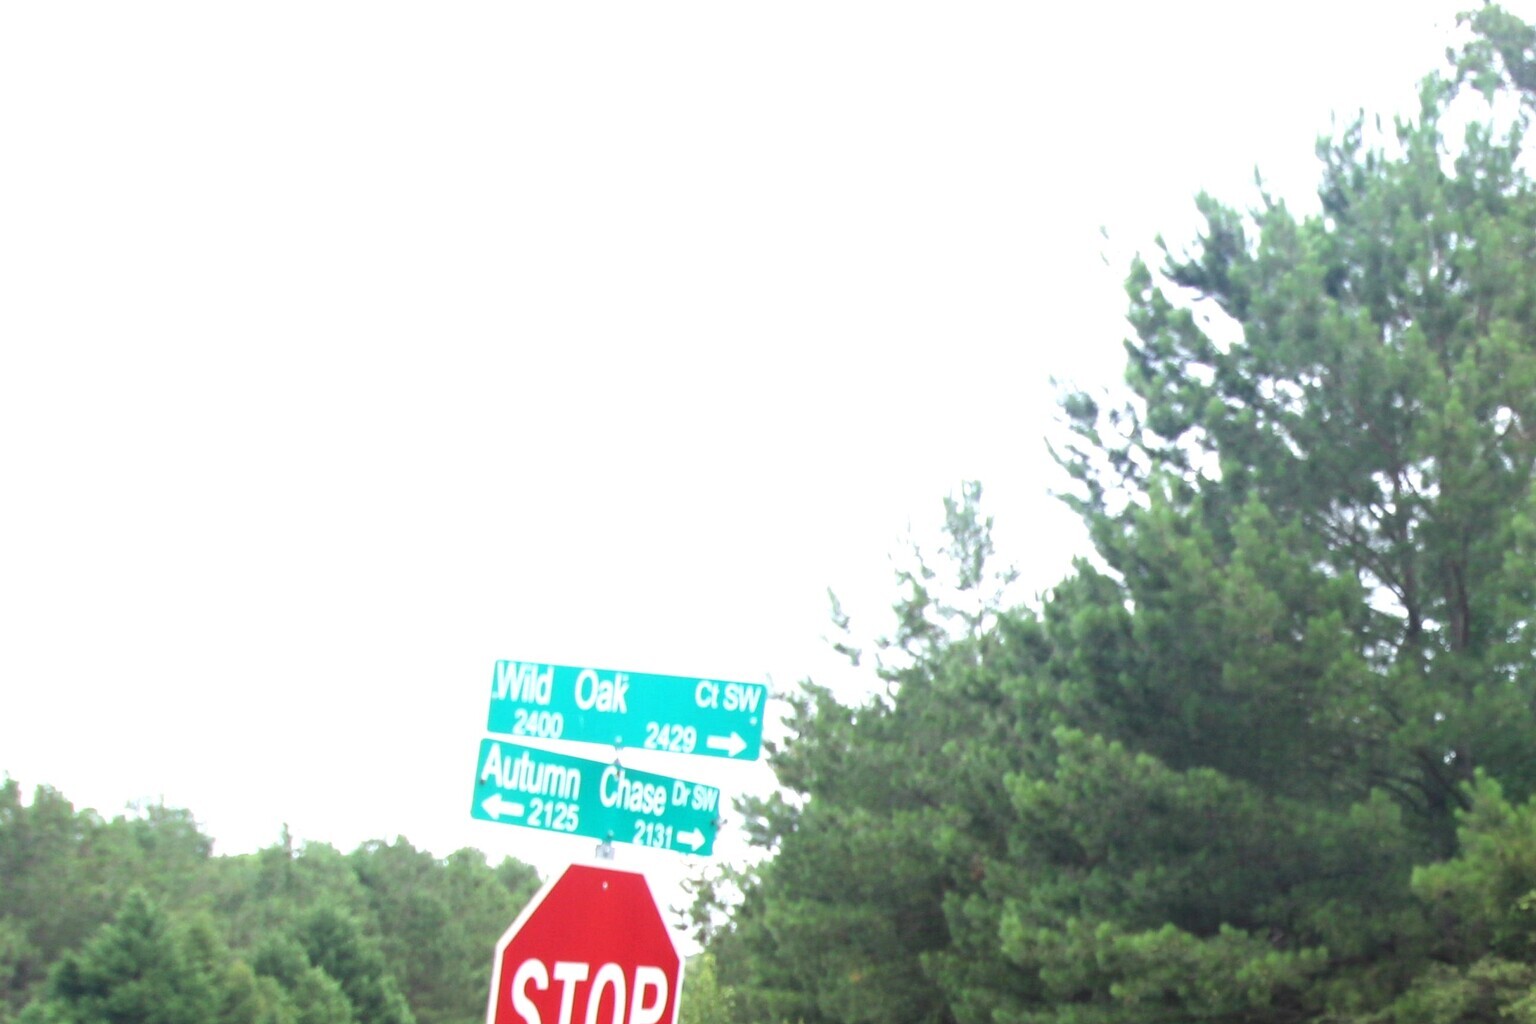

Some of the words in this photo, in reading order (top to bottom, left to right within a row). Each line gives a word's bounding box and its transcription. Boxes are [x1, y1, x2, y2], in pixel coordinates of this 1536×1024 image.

[495, 661, 554, 705] Wild
[574, 668, 630, 713] Oak
[694, 681, 718, 709] Ct
[723, 684, 762, 712] SW
[512, 708, 564, 739] 2400
[643, 721, 697, 753] 2429
[480, 743, 581, 801] Autumn
[600, 765, 667, 816] Chase
[671, 780, 691, 807] Dr
[692, 785, 719, 812] SW
[526, 797, 579, 832] 2125
[632, 820, 673, 849] 2131
